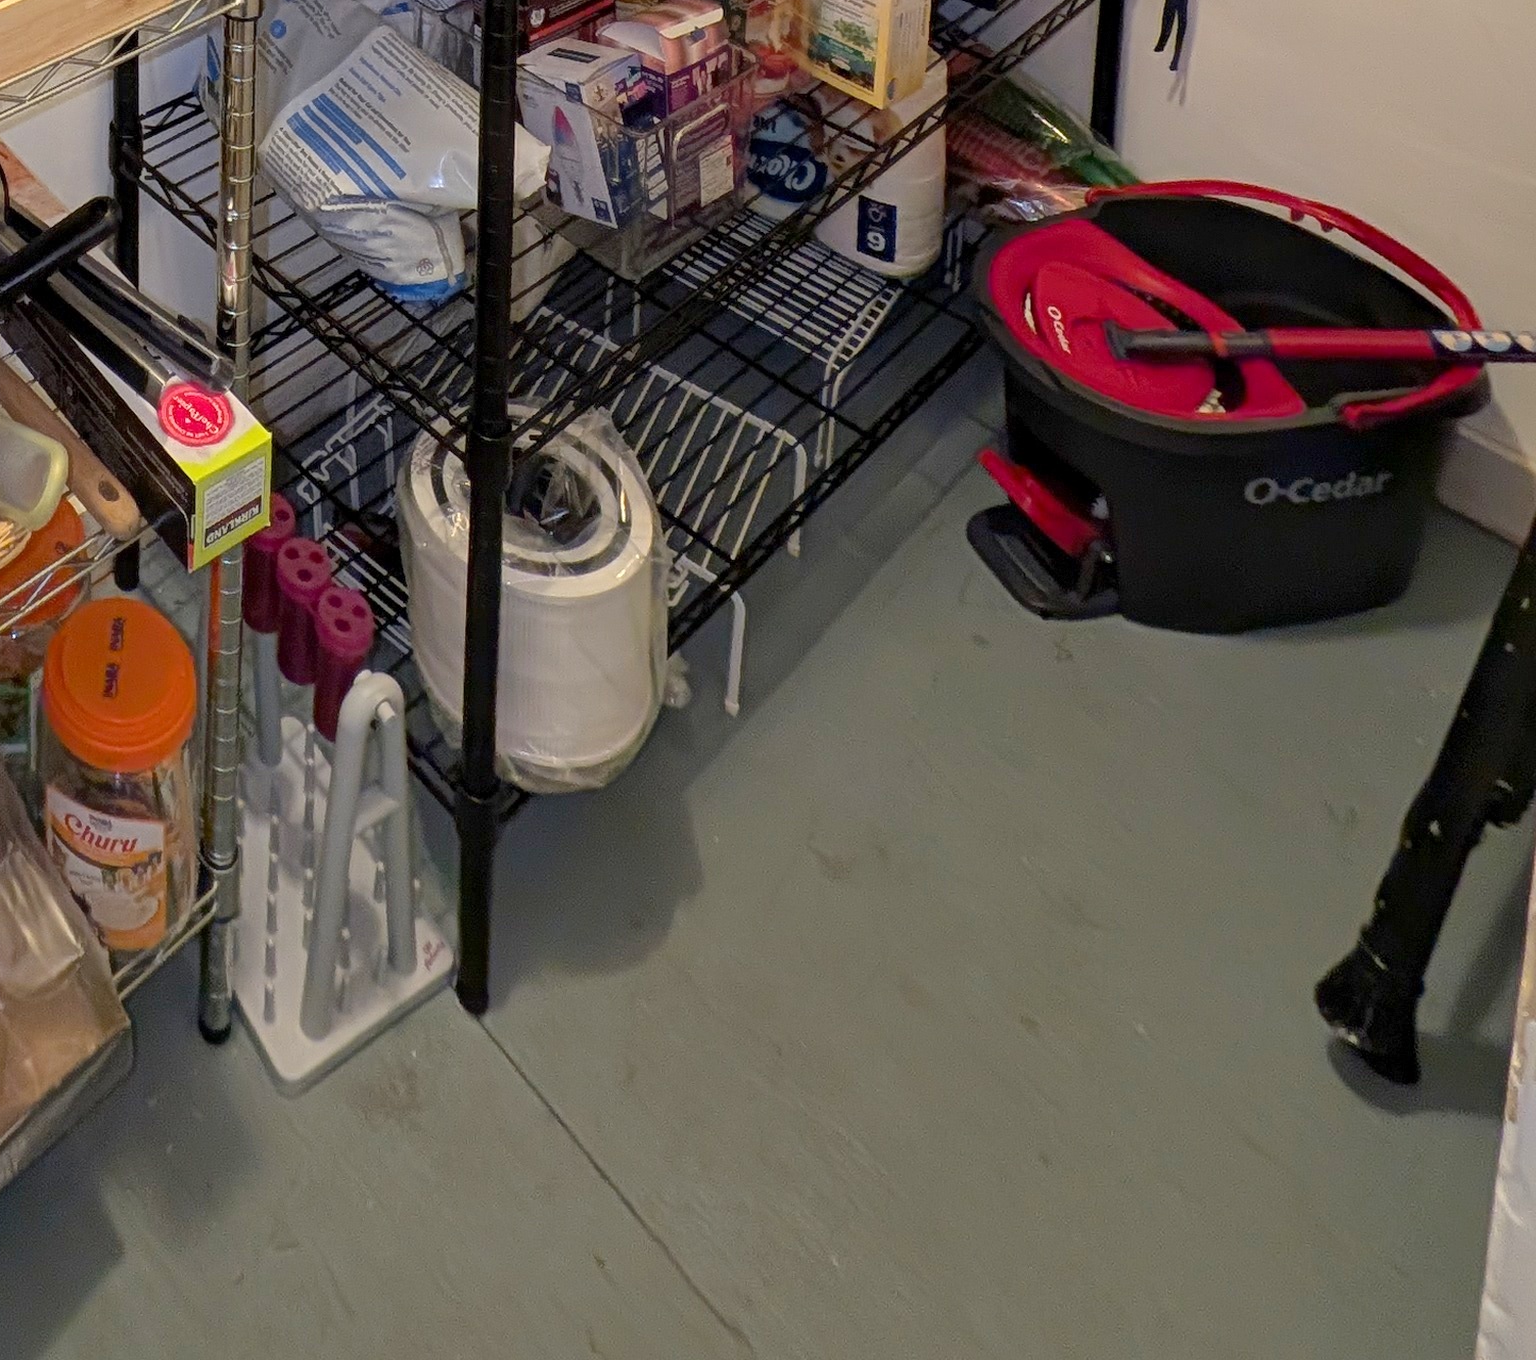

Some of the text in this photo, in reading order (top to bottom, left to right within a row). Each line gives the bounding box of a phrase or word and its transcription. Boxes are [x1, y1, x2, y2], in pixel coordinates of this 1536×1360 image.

[1244, 472, 1395, 506] O-Cedar
[205, 503, 261, 545] KIRKLAND
[64, 813, 138, 853] Churu
